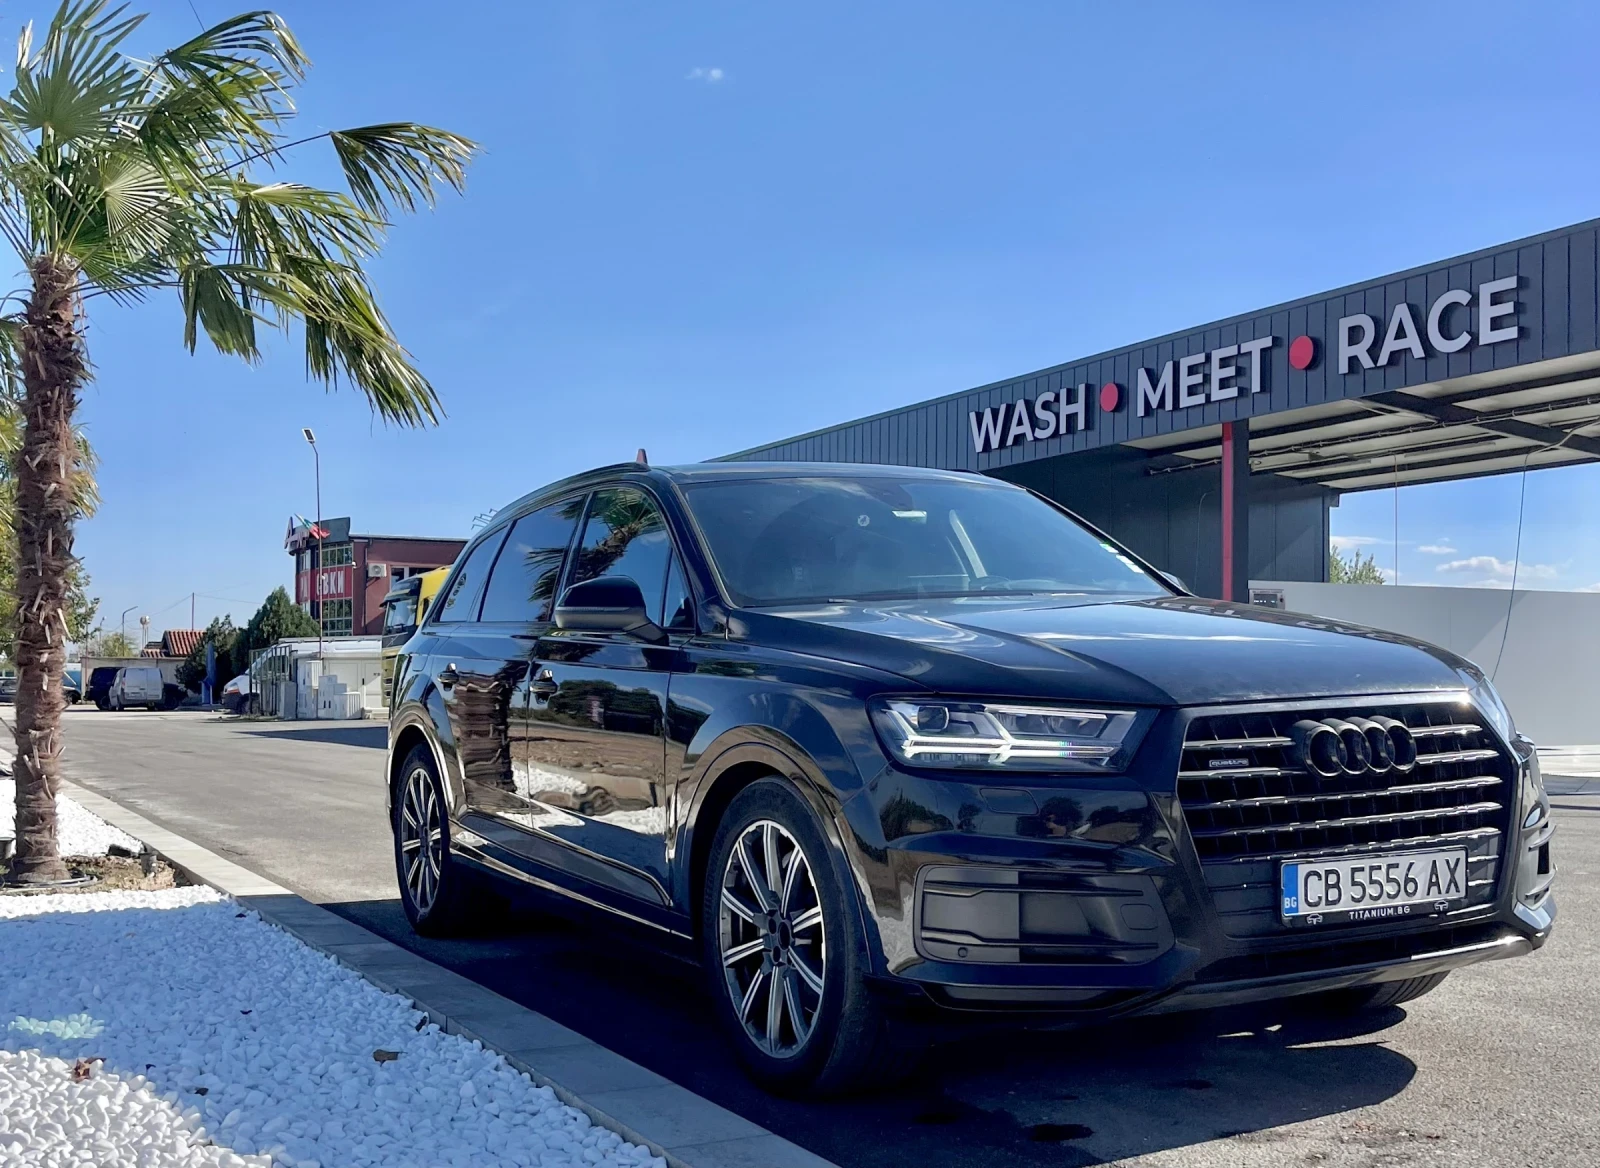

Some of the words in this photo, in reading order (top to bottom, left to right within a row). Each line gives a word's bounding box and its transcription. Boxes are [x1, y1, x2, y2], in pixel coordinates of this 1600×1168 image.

[969, 384, 1087, 453] WASH
[1137, 336, 1276, 417] MEET
[1338, 275, 1521, 374] RACE
[1304, 868, 1342, 907] CB
[1350, 862, 1419, 903] 5556
[1426, 858, 1461, 896] AX
[1284, 897, 1297, 908] BG
[1349, 906, 1410, 920] TITANIUM.BG
